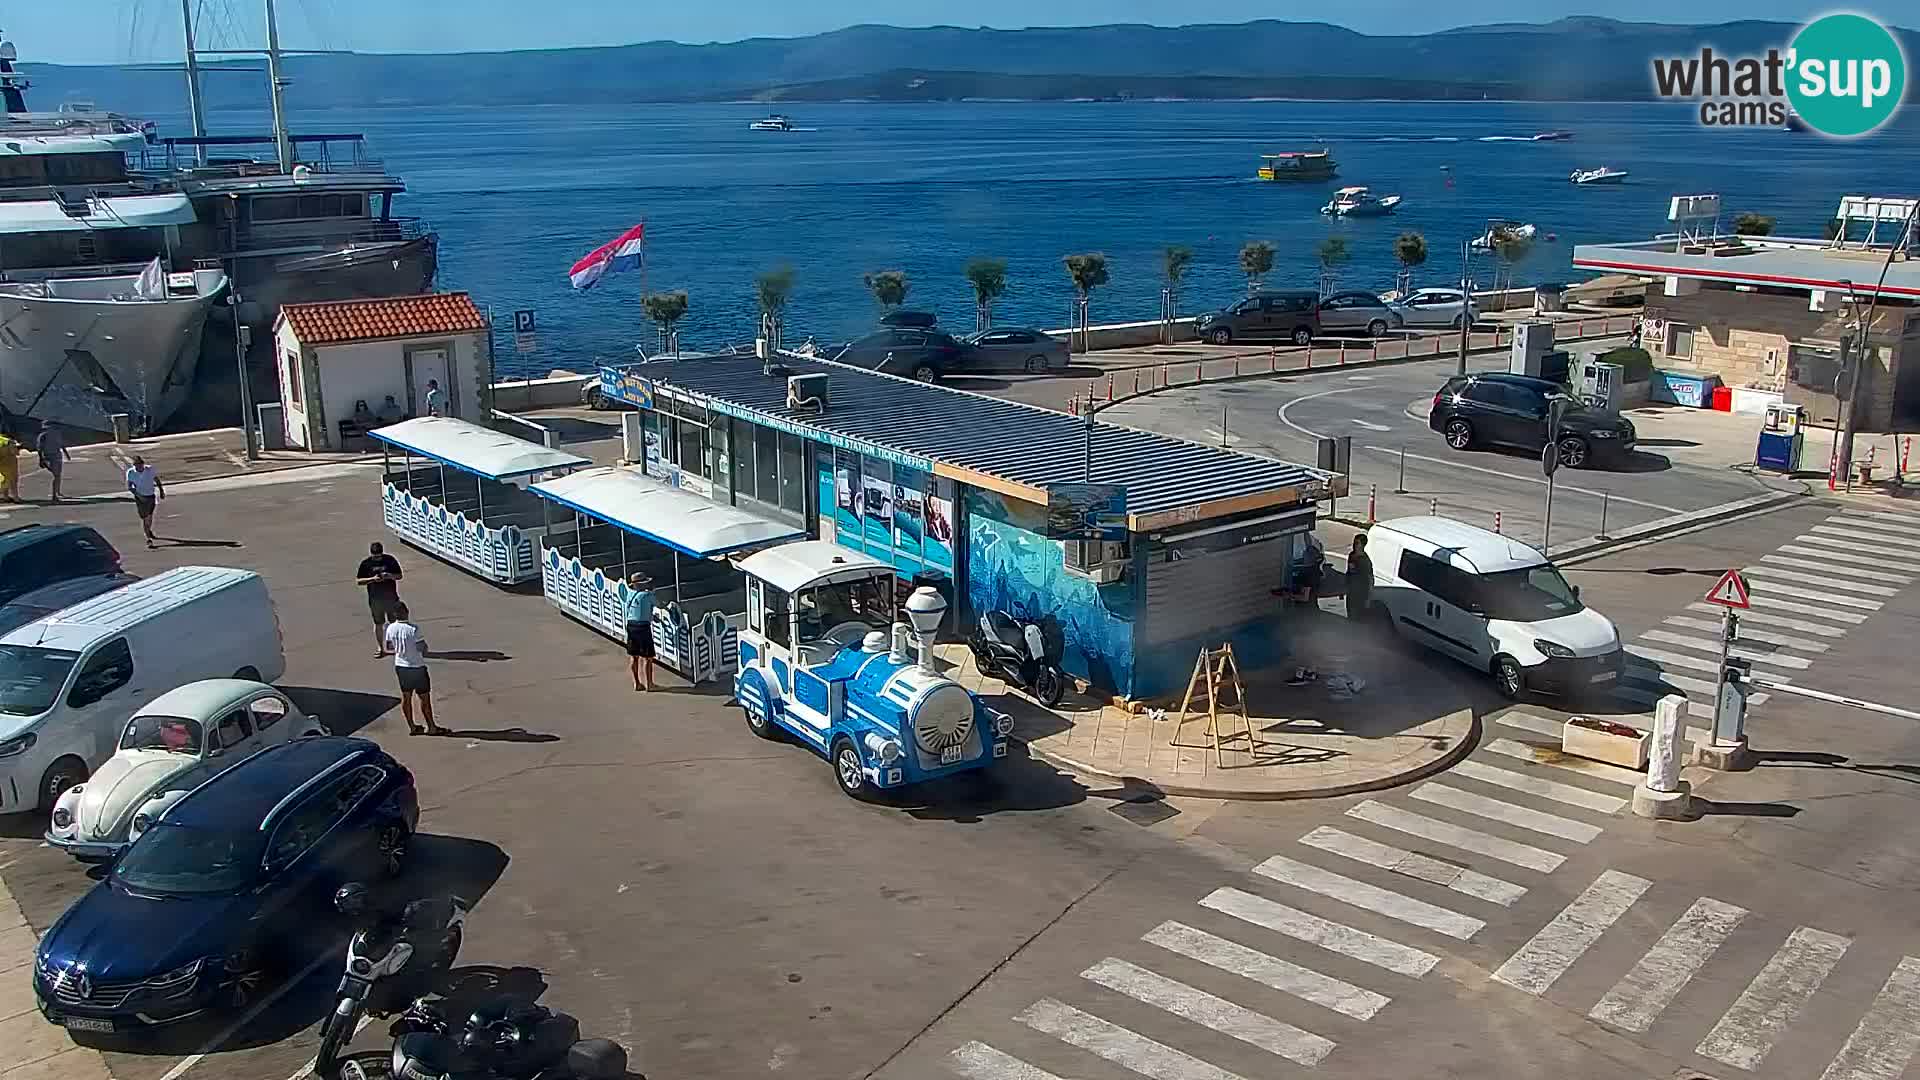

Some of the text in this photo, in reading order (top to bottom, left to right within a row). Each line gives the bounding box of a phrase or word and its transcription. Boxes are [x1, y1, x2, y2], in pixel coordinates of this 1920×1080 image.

[519, 312, 530, 330] P
[792, 424, 821, 440] POSTAJA
[830, 434, 844, 447] BUS
[845, 439, 875, 456] STATION
[878, 449, 901, 464] TICKET
[902, 455, 928, 471] OFFICE
